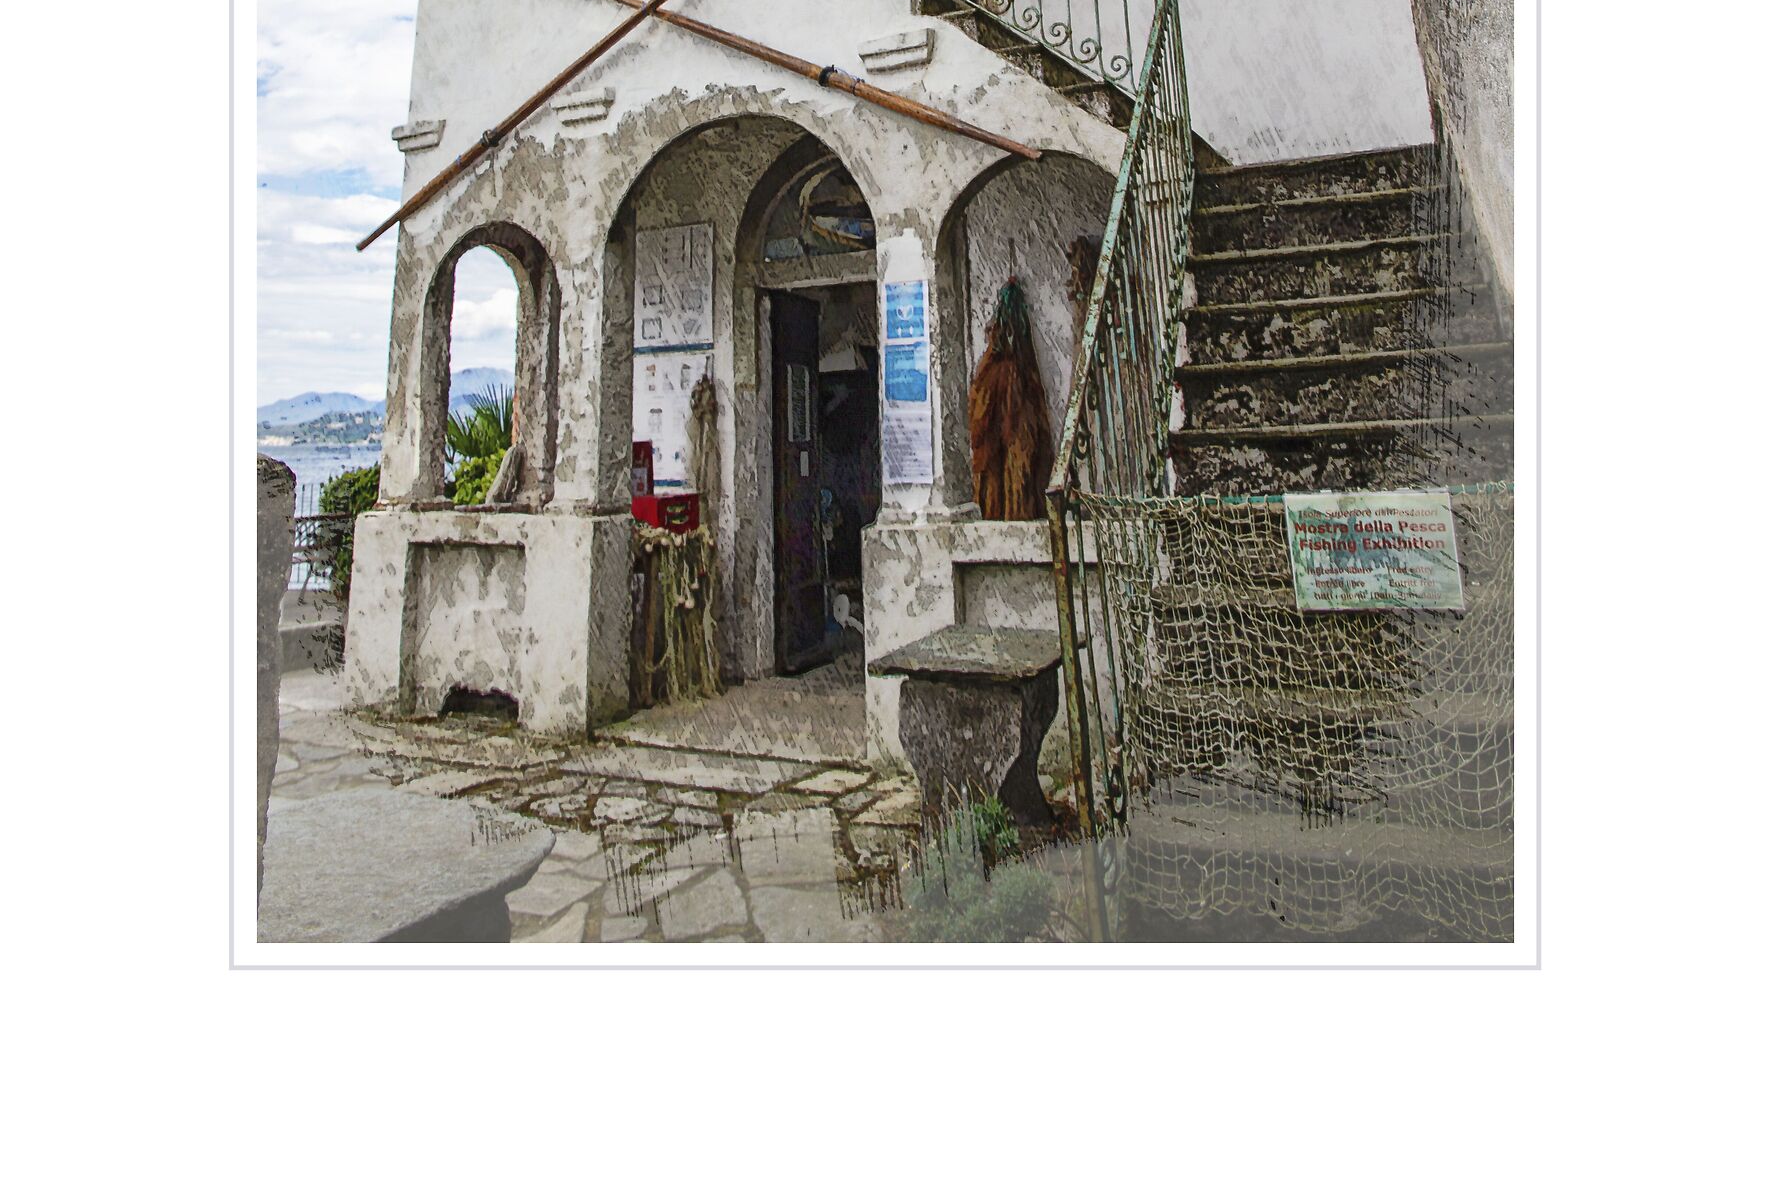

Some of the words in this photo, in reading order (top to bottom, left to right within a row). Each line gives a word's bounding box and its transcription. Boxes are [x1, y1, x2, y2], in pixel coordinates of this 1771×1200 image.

[1294, 521, 1349, 535] Mostra
[1354, 519, 1393, 533] della
[1398, 520, 1446, 533] Pesca
[1299, 538, 1357, 554] Fishing
[1362, 536, 1445, 551] Exhibition
